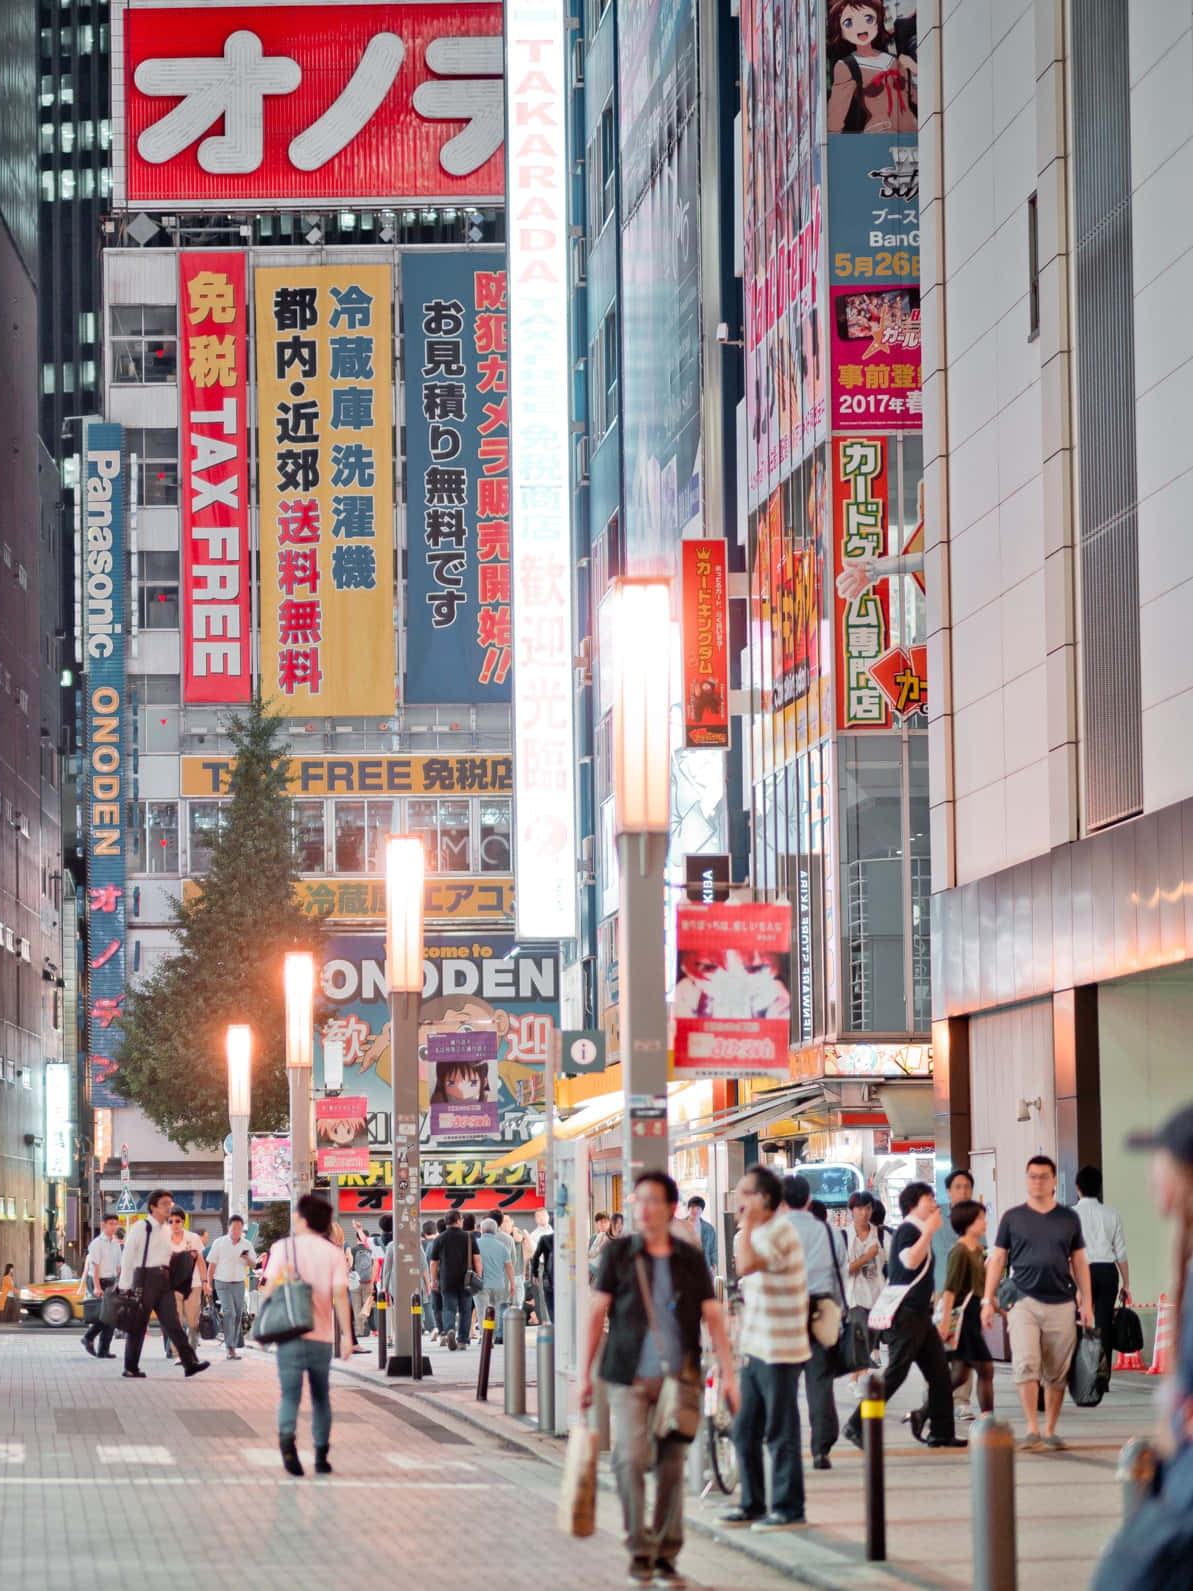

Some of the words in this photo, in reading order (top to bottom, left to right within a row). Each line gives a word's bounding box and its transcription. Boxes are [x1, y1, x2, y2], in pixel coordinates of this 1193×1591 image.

[515, 39, 558, 283] TAKARADA
[187, 269, 238, 388] 免税
[838, 364, 922, 389] 事前登
[189, 398, 239, 511] TAX
[421, 300, 467, 629] お見積り無料です
[87, 450, 122, 659] Panasonic
[191, 527, 242, 678] FREE
[842, 442, 878, 720] カードゲム専門店
[92, 686, 121, 856] ONODEN
[301, 760, 412, 792] FREE
[423, 883, 514, 915] エアコ
[473, 943, 494, 959] to
